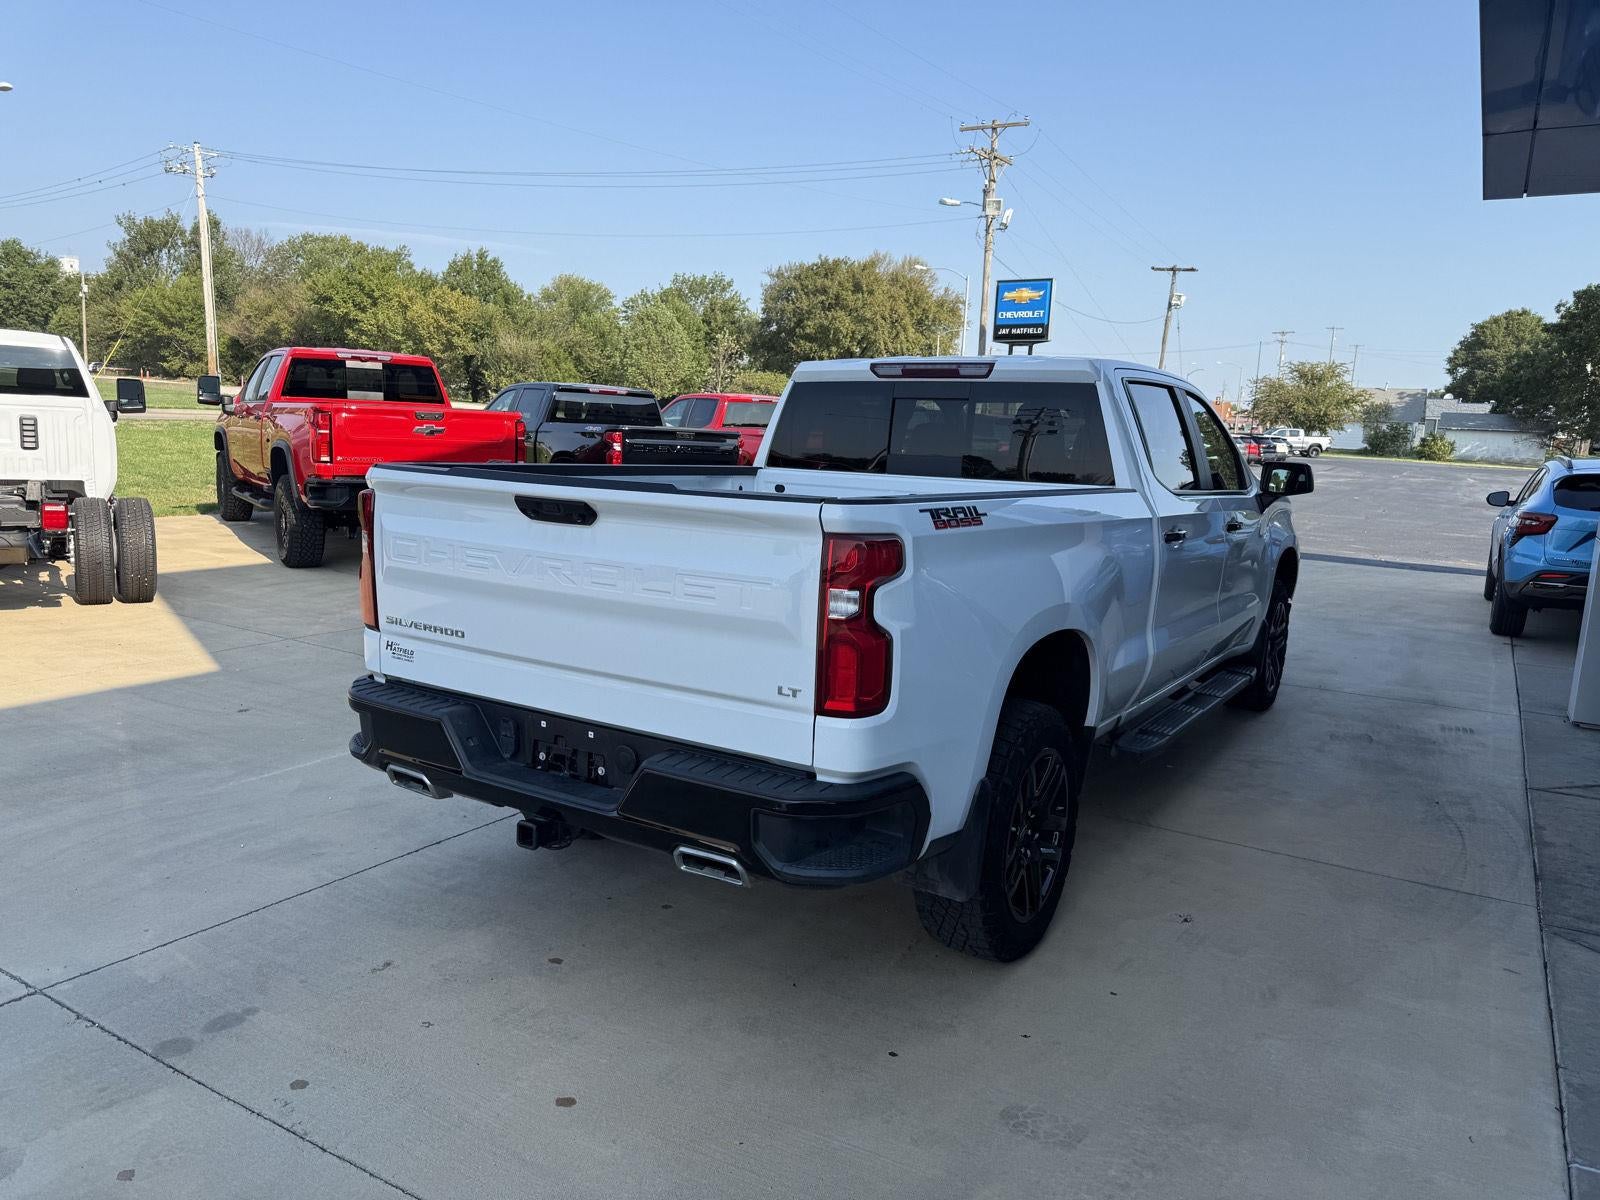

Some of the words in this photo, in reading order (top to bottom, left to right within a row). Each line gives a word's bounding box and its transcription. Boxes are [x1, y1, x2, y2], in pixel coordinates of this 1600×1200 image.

[998, 310, 1045, 319] CHEVROLET
[919, 505, 988, 519] TRAIL
[389, 536, 777, 609] CHEVROLET
[385, 615, 466, 638] SILVERADO
[385, 640, 415, 656] HATFIELD
[777, 685, 802, 698] LT
